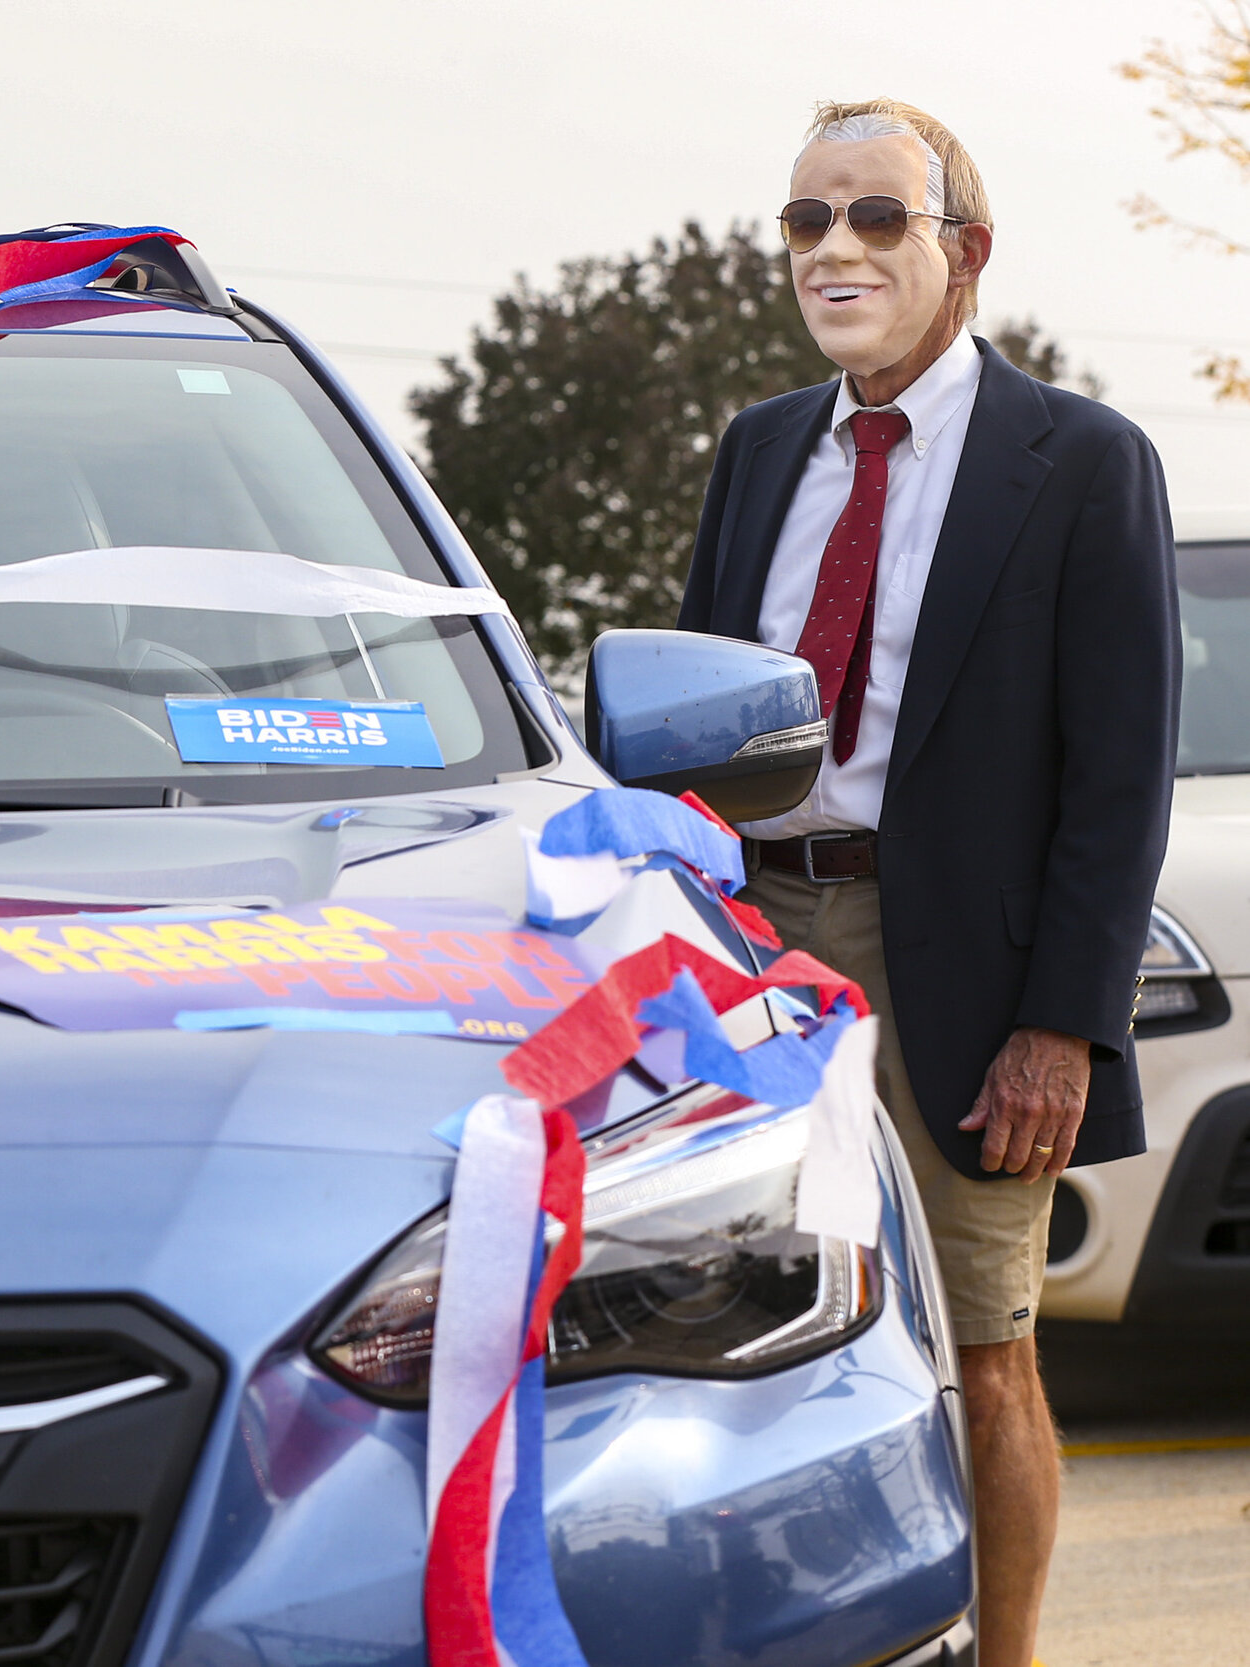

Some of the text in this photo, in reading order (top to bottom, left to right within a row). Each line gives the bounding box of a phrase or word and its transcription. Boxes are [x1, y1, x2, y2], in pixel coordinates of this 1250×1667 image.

[216, 709, 382, 730] BIDEN
[222, 727, 388, 746] HARRIS
[271, 746, 349, 754] JoeBiden.com
[11, 930, 572, 974] HARRIS FOR
[114, 961, 595, 1010] THE PEOPLE
[458, 1018, 530, 1038] .ORG
